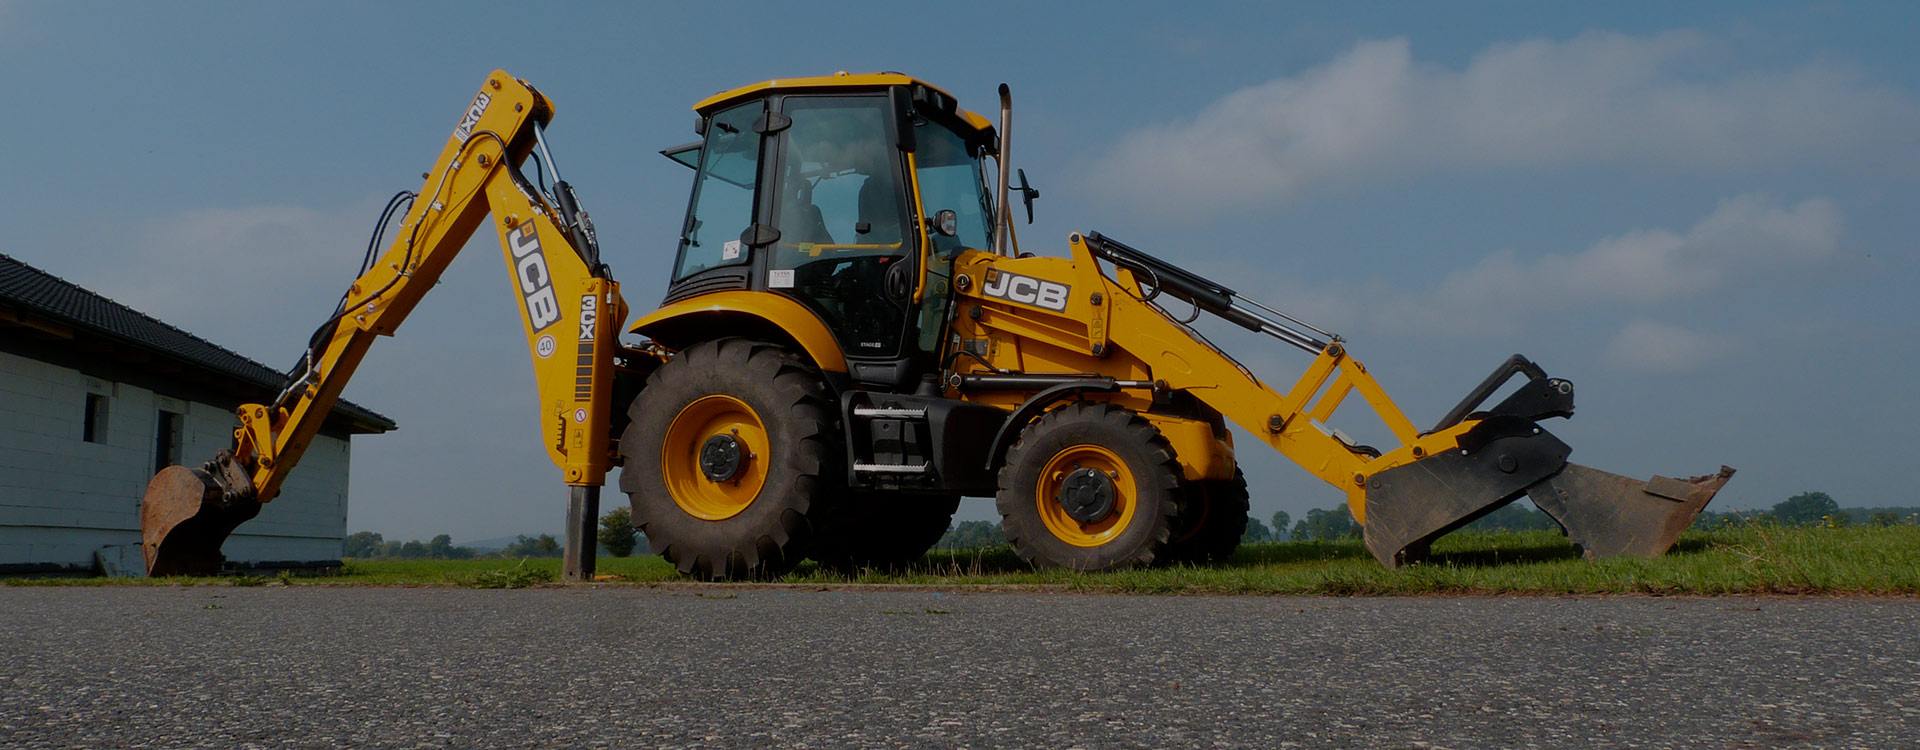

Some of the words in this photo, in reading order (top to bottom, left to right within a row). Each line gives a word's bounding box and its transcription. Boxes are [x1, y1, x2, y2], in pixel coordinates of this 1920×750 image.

[460, 92, 491, 134] 3CX
[509, 228, 559, 330] JCB
[984, 272, 1068, 311] JCB
[580, 295, 596, 340] 3CX
[539, 340, 552, 353] 40
